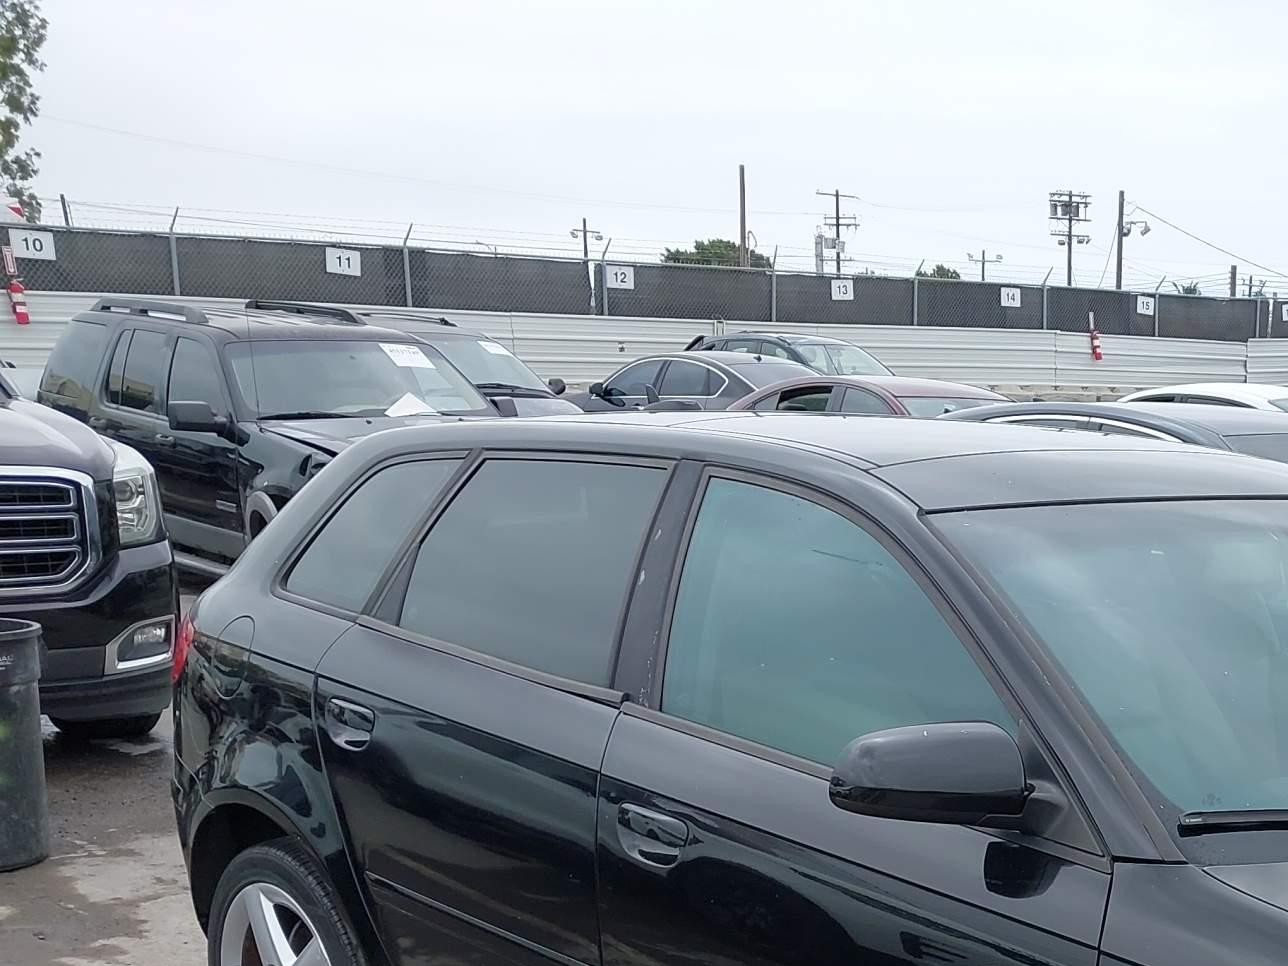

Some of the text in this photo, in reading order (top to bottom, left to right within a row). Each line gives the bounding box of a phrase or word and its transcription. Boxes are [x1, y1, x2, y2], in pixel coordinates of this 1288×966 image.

[22, 237, 43, 252] 10
[336, 255, 351, 269] 11
[613, 271, 627, 284] 12
[837, 285, 848, 295] 13
[1006, 293, 1015, 303] 14
[1141, 301, 1150, 310] 15
